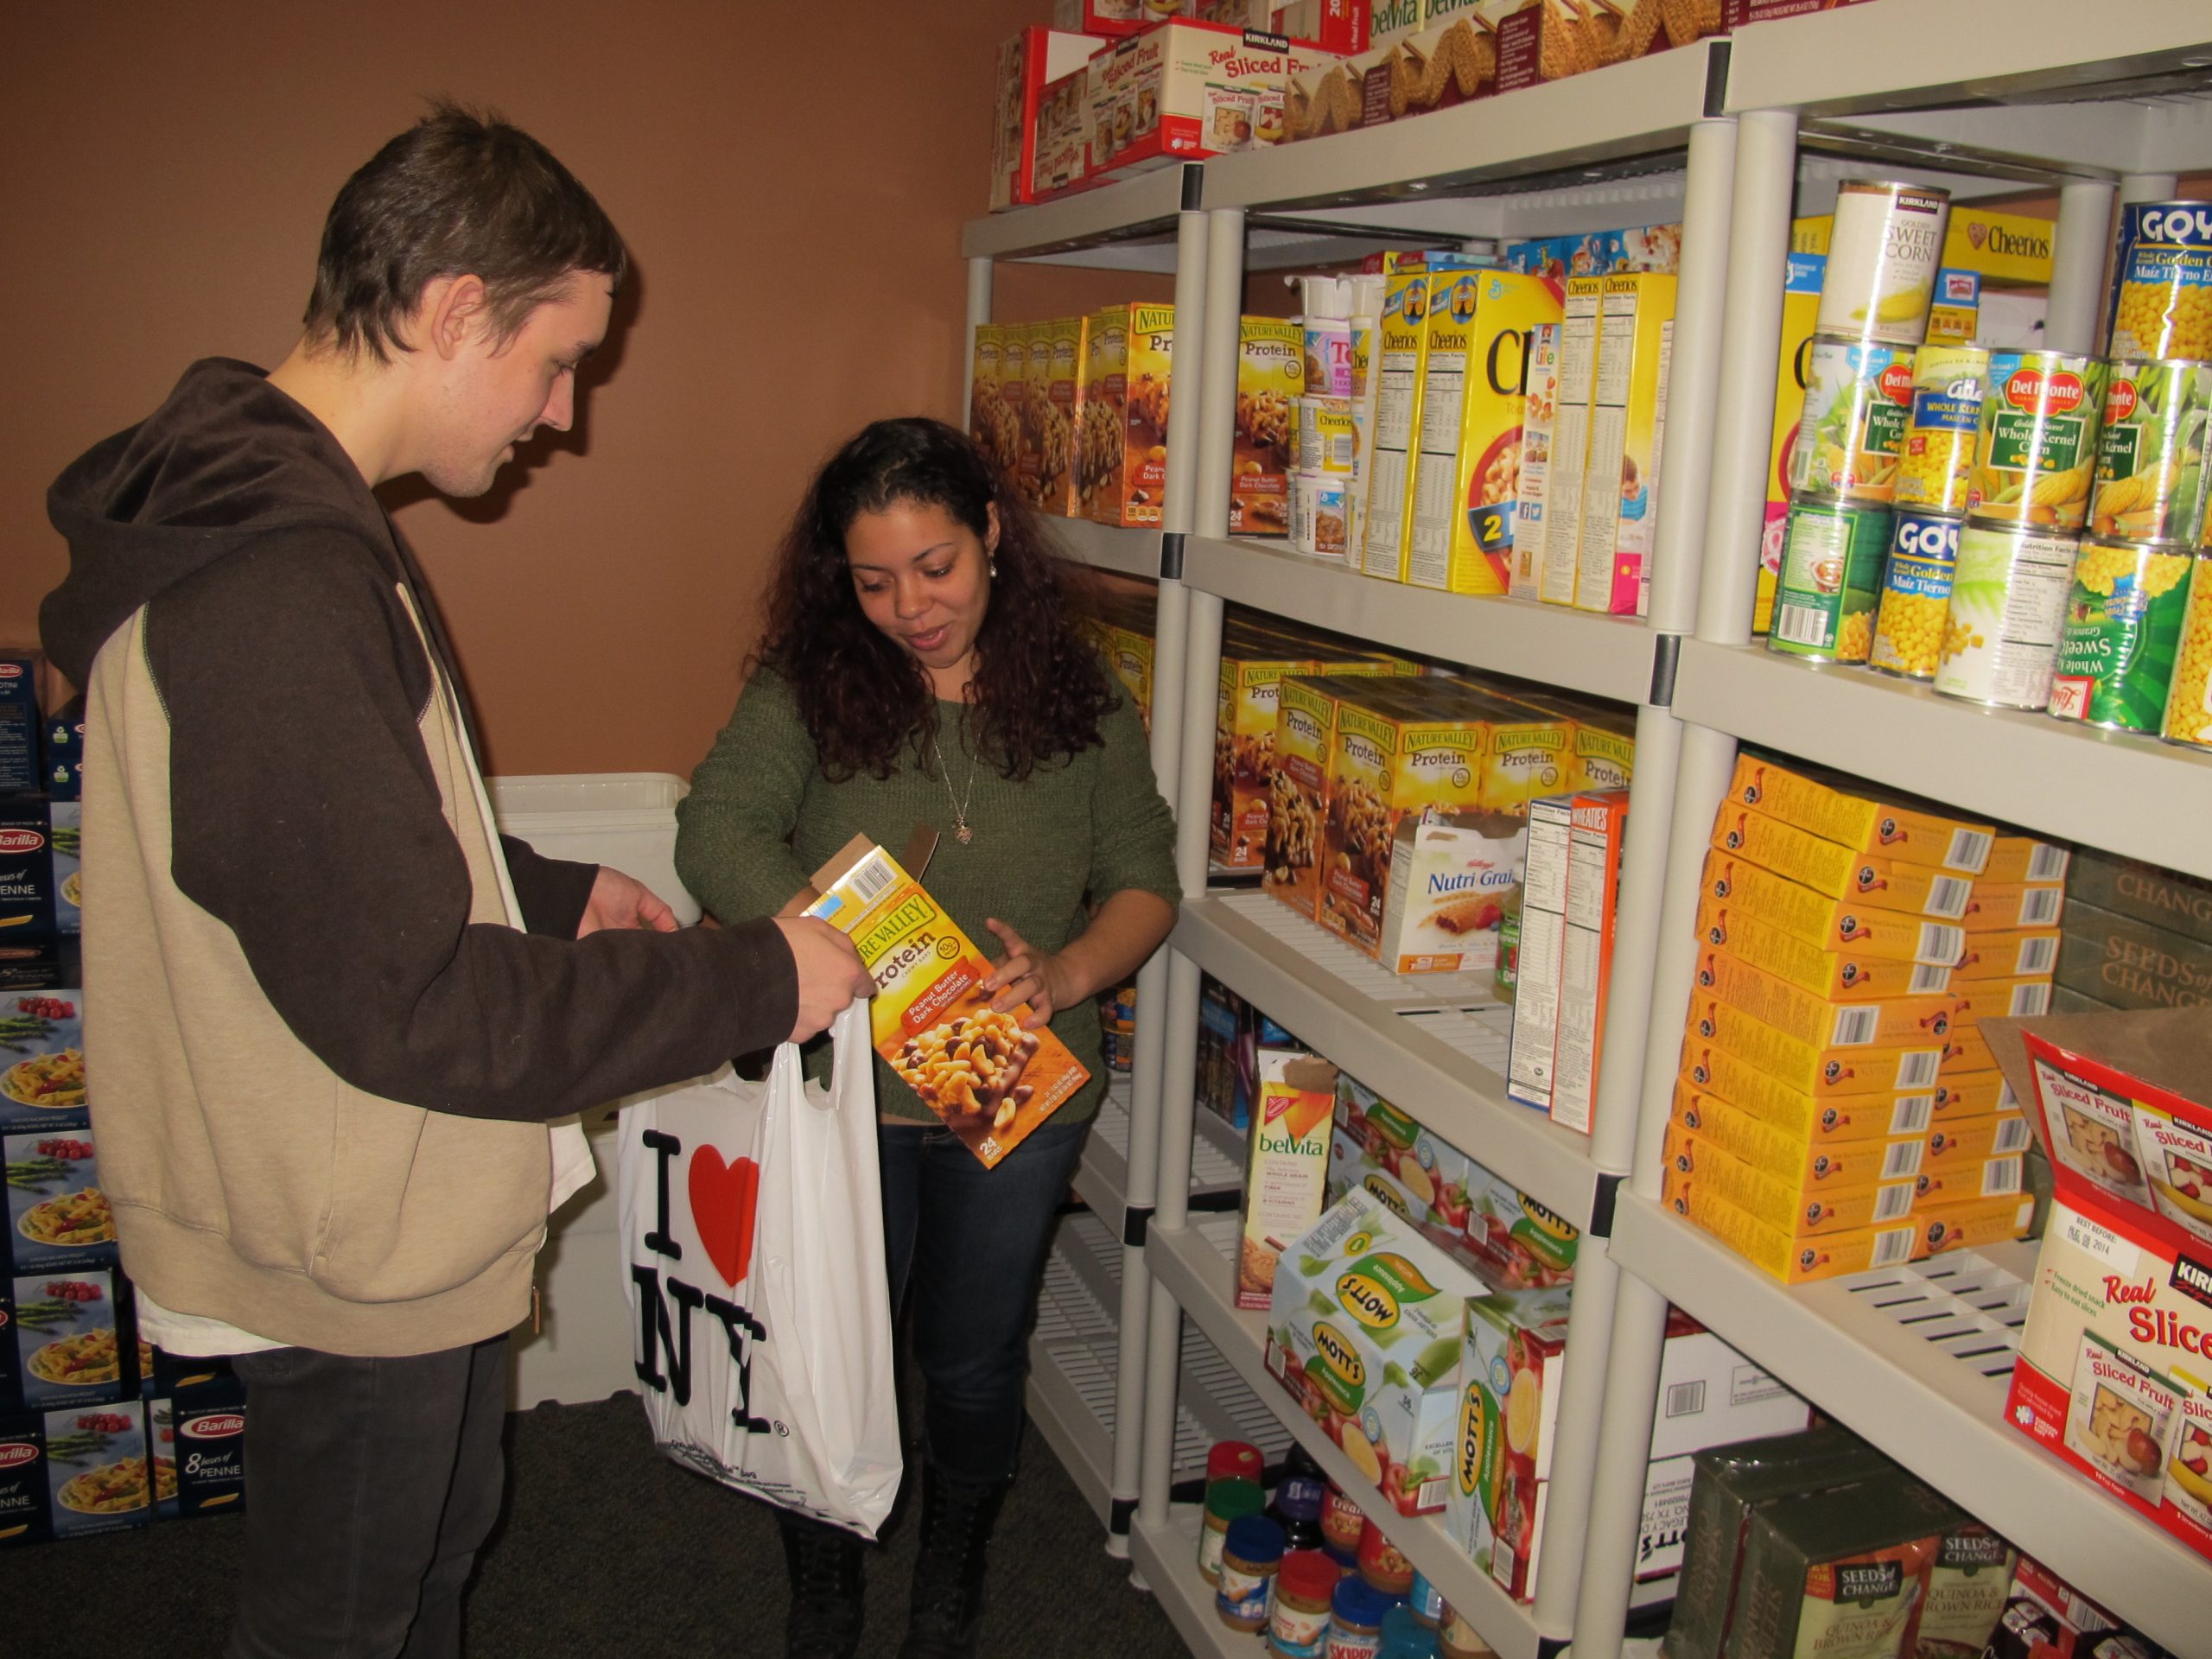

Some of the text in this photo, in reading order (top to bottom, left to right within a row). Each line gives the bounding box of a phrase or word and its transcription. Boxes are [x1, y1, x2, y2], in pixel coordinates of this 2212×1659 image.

[1244, 32, 1288, 49] KIRKLAND
[1136, 41, 1160, 67] Fruit
[1208, 46, 1236, 66] Real
[1225, 57, 1282, 79] Sliced
[1899, 195, 1939, 210] KIRKLAND
[1901, 219, 1931, 229] GOLDEN
[2142, 210, 2212, 242] GOY
[1885, 226, 1938, 246] SWEET
[1988, 226, 2050, 259] Cheerios
[1885, 243, 1934, 263] CORN
[1567, 280, 1599, 296] Cheerios
[1605, 276, 1638, 296] Cheerios
[1139, 308, 1175, 328] NATU
[1241, 323, 1303, 342] NATURE VALLEY
[1383, 330, 1418, 350] Cheerios
[1429, 329, 1467, 351] Cheerios
[1245, 342, 1297, 357] Protein
[1885, 373, 1901, 387] Del
[2011, 379, 2031, 395] Del
[1927, 402, 1955, 413] WHOLE
[1319, 415, 1353, 428] Cheerios
[1872, 416, 1900, 429] Whole
[1998, 427, 2076, 447] Whole Kernel
[2105, 441, 2132, 454] Kernel
[1230, 510, 1243, 522] 24
[1483, 515, 1502, 542] 2
[1898, 522, 1960, 556] GOY
[1910, 565, 1955, 582] Golden
[1916, 581, 1951, 595] Tierno
[2064, 637, 2112, 658] Sweet
[2065, 658, 2104, 673] Whole
[1246, 669, 1278, 683] NATURE
[1281, 683, 1332, 726] NATURE VALLEY
[1286, 710, 1323, 741] Protein
[1339, 707, 1395, 753] NATURE VALLEY
[1407, 732, 1476, 750] NATURE VALLEY
[1498, 732, 1562, 749] NATURE VALLEY
[1578, 733, 1633, 761] NATURE VALL
[1344, 736, 1386, 767] Protein
[1411, 752, 1466, 767] Protein
[1501, 751, 1554, 767] Protein
[1571, 807, 1608, 831] WHEATIES
[1235, 848, 1248, 857] 24
[17, 868, 28, 882] of
[1427, 869, 1515, 895] Nutri Grai
[0, 884, 35, 895] ENNE
[2117, 873, 2212, 922] CHANG
[1370, 895, 1381, 910] 24
[878, 897, 929, 944] VALLEY
[873, 931, 938, 989] rotein
[901, 950, 932, 979] CHEWY BARS
[2106, 934, 2196, 986] SEEDS
[908, 969, 958, 1016] Peanut Butter
[2101, 961, 2212, 1009] CHANG
[912, 973, 969, 1025] Dark Chocolate
[2050, 1082, 2132, 1123] Sliced Fruit
[2142, 1118, 2164, 1131] Real
[979, 1136, 998, 1155] 24
[2155, 1130, 2206, 1155] Sliced
[986, 1146, 1003, 1161] BARS
[642, 1128, 682, 1262] I
[1368, 1181, 1407, 1212] MOTT'S
[1522, 1194, 1572, 1235] MOTT'S
[2076, 1215, 2118, 1245] BEST BEFORE:
[2093, 1238, 2111, 1255] 2014
[1372, 1264, 1406, 1294] Applesauce
[2102, 1274, 2158, 1304] Real
[1341, 1277, 1394, 1322] MOTT'S
[2051, 1282, 2098, 1318] Easy to eat slices
[2053, 1271, 2106, 1310] Freeze dried snack
[2128, 1306, 2212, 1361] Slice
[632, 1262, 772, 1434] NY
[1318, 1329, 1361, 1381] MOTT'S
[2086, 1348, 2104, 1360] Real
[2116, 1349, 2151, 1375] KIRKLAND
[1320, 1366, 1351, 1400] Applesauce
[2092, 1361, 2176, 1412] Sliced Fruit
[1402, 1393, 1413, 1409] 36
[2183, 1399, 2212, 1421] Slic
[197, 1416, 245, 1433] Barilla
[1462, 1391, 1483, 1484] MOTT'S
[0, 1446, 33, 1460] arilla
[1483, 1420, 1495, 1481] Applesauce
[185, 1452, 201, 1475] 8
[221, 1452, 233, 1463] of
[200, 1465, 241, 1478] PENNE
[10, 1480, 21, 1493] of
[0, 1495, 30, 1507] NNE
[1332, 1497, 1364, 1515] Crea
[2180, 1498, 2190, 1510] Net
[1658, 1508, 1669, 1518] TX
[1641, 1529, 1688, 1554] OTT'S
[1946, 1537, 2000, 1551] SEEDS of
[1944, 1549, 1999, 1562] CHANGE
[1841, 1566, 1897, 1585] SEEDS of
[1841, 1580, 1896, 1597] CHANGE
[1927, 1587, 1999, 1599] QUINOA &
[1925, 1600, 2005, 1612] ROWN RICE
[1825, 1618, 1891, 1637] QUINOA &
[1813, 1631, 1862, 1650] BROWN
